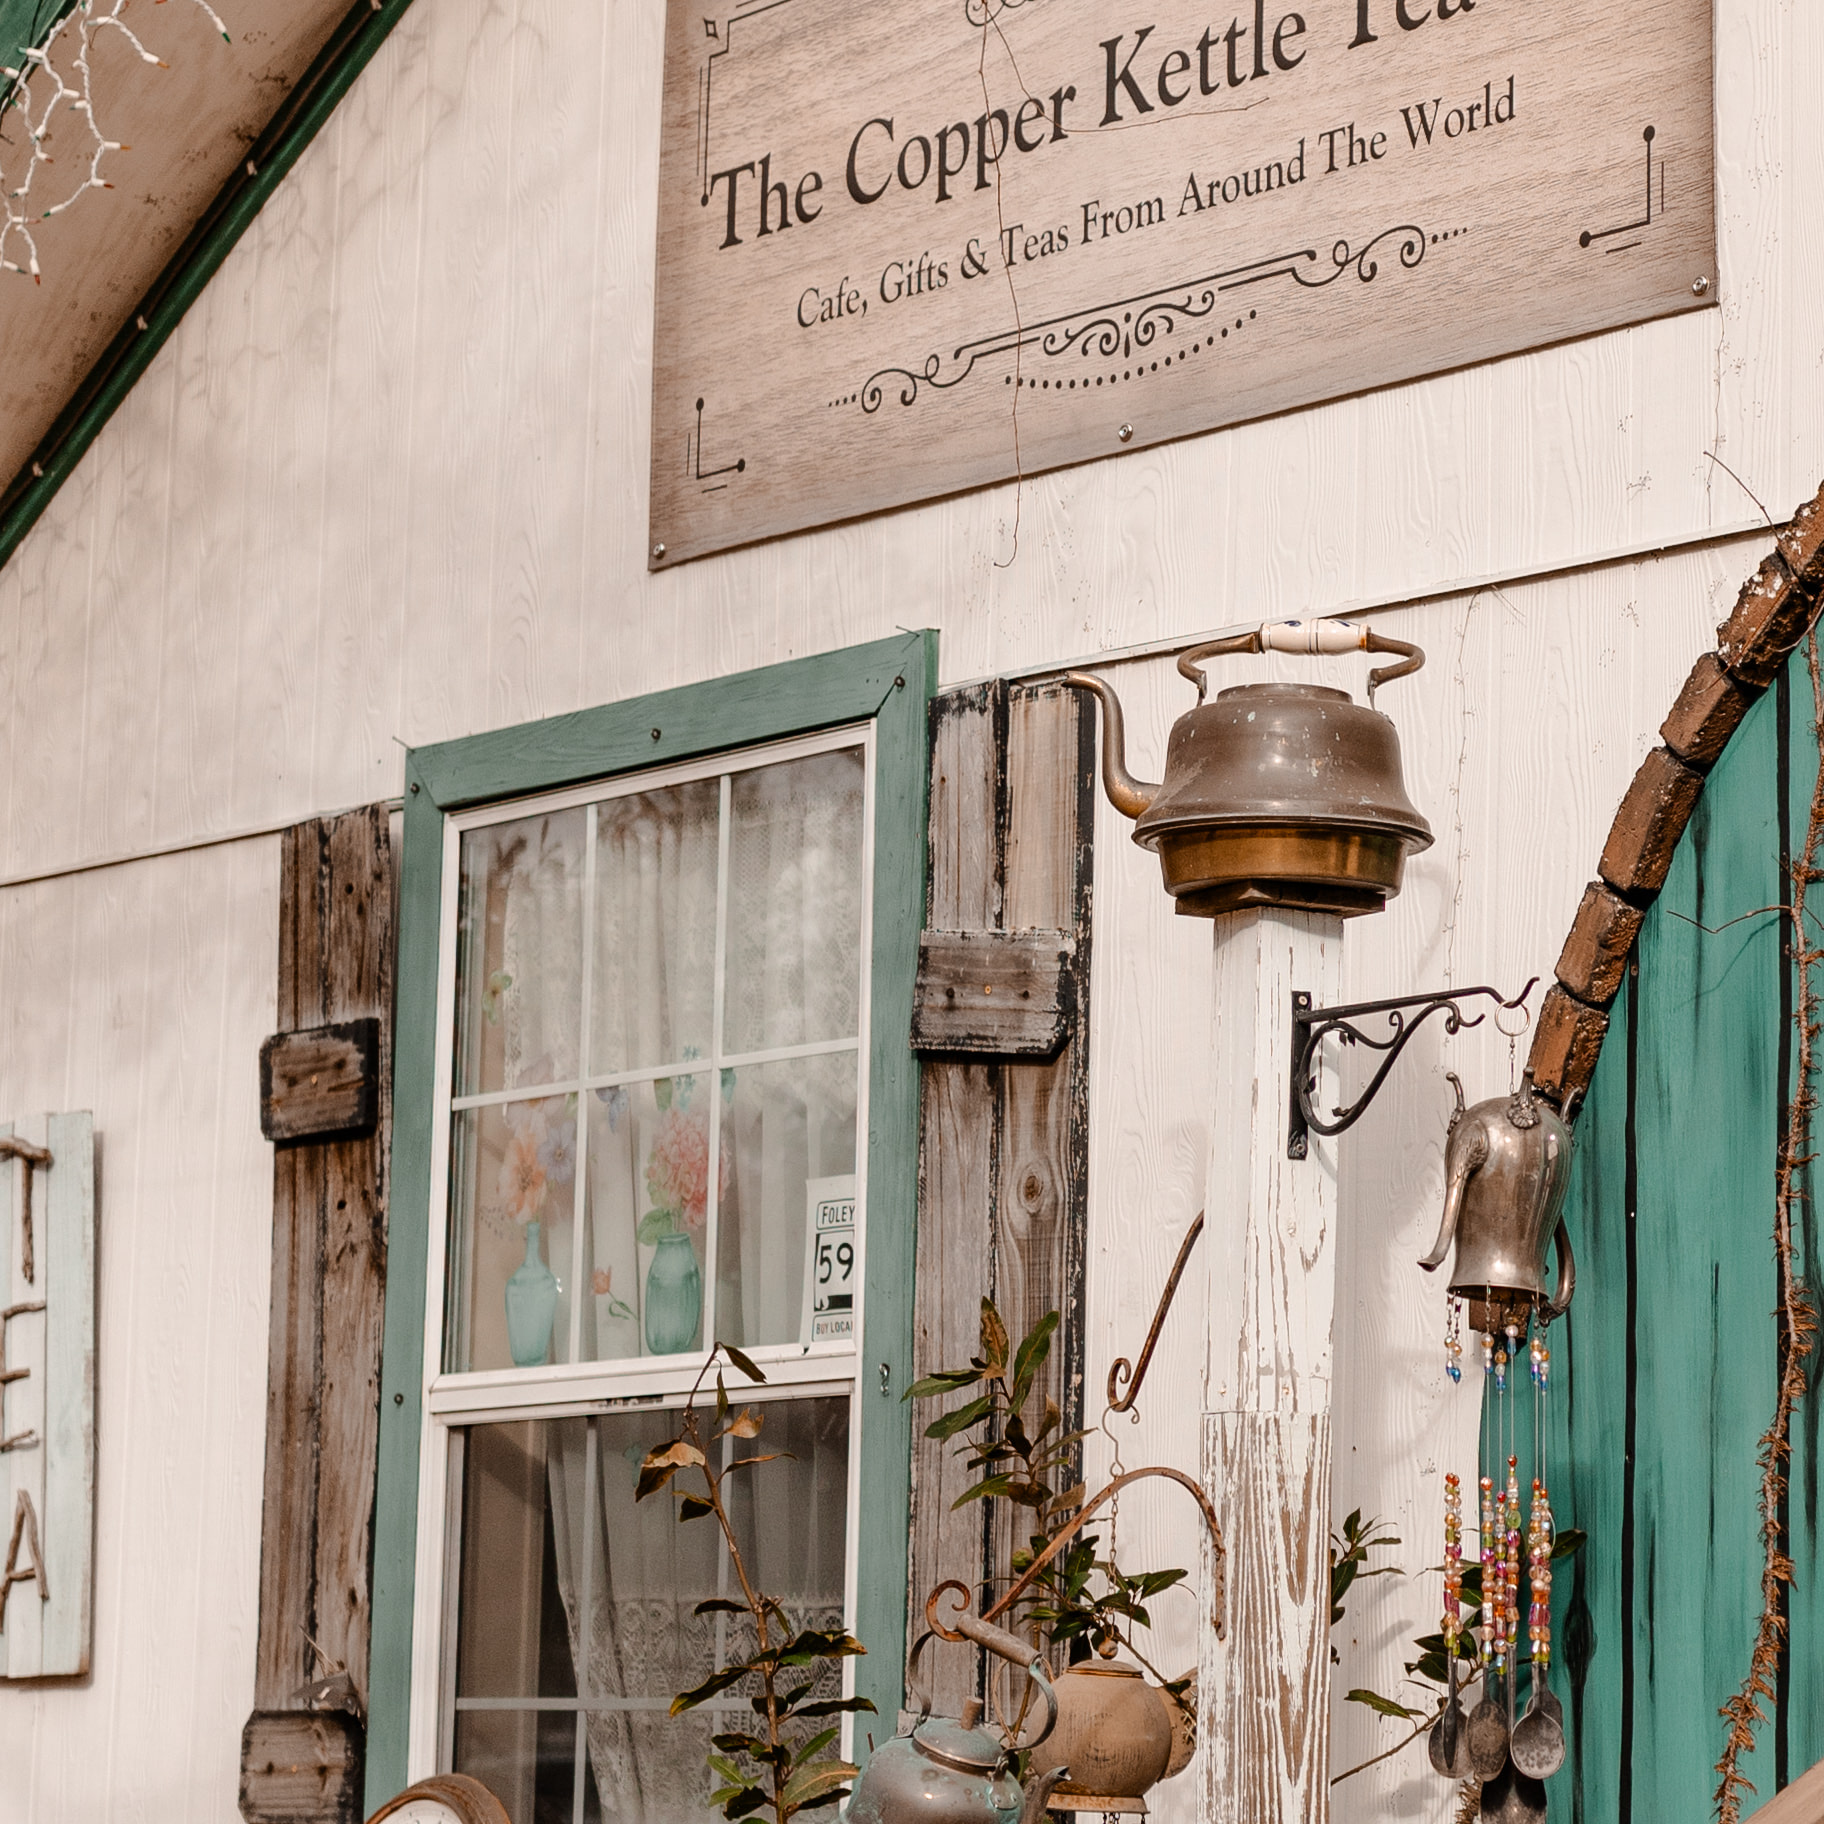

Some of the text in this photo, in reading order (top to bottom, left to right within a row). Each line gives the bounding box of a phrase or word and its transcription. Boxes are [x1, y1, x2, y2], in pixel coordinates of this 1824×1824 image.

[710, 152, 824, 250] The
[845, 85, 1077, 206] Copper
[796, 75, 1516, 328] Cafe, Gifts & Teas From Around The World
[822, 1205, 855, 1224] FOLEY
[819, 1242, 854, 1284] 59
[816, 1323, 829, 1335] BUY
